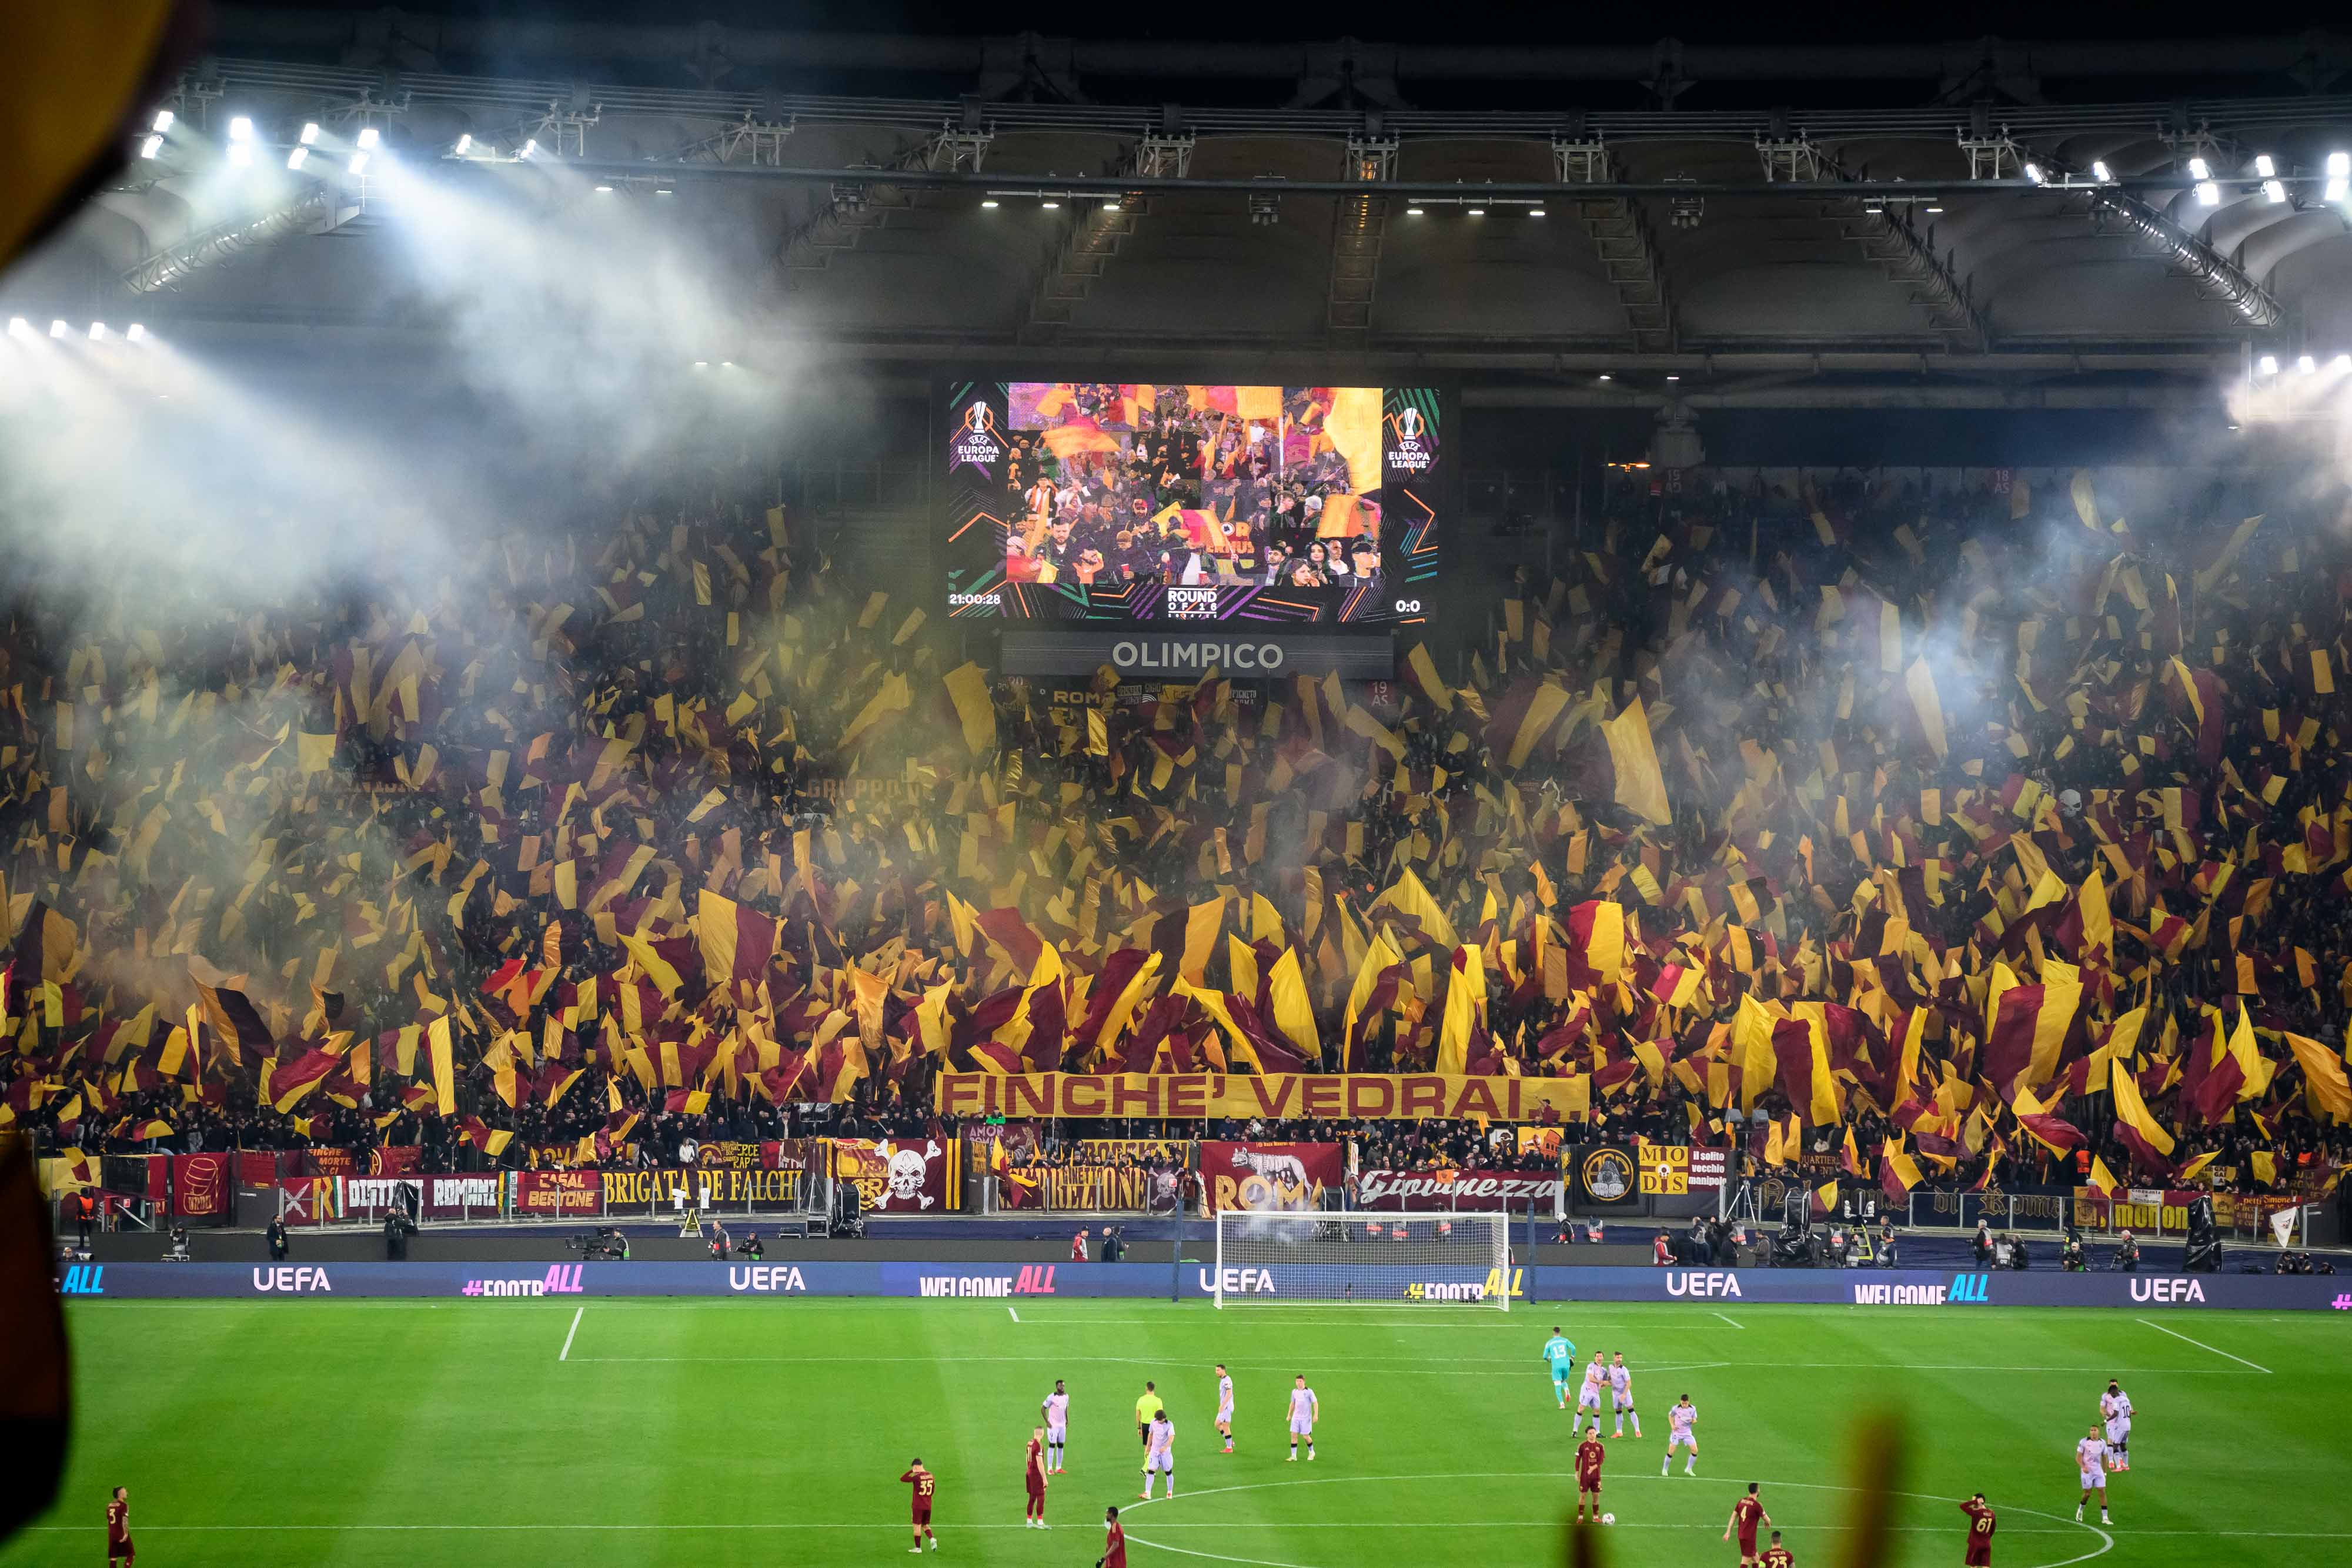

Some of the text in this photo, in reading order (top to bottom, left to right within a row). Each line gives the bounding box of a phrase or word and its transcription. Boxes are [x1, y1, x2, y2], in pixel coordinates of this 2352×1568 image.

[958, 446, 1000, 454] EUROPA
[1388, 452, 1430, 461] EUROPA
[950, 594, 1001, 604] 21:00:28
[1168, 590, 1217, 603] ROUND
[1168, 602, 1217, 611] OF 16
[1395, 600, 1421, 612] 0:0
[1113, 642, 1284, 668] OLIMPICO
[1373, 681, 1388, 694] 19
[1372, 694, 1388, 706] AS
[943, 1075, 1225, 1116] FINCHE'
[970, 1125, 1004, 1137] AMOR
[319, 1157, 351, 1166] MORTE
[1700, 1152, 1725, 1161] solito
[1692, 1164, 1725, 1173] vecchio
[540, 1174, 584, 1188] CASAL
[602, 1169, 803, 1203] BRIGATA DE FALCHI
[1361, 1171, 1557, 1204] Giovinezza
[1688, 1176, 1726, 1186] manipolo
[433, 1179, 497, 1206] ROMANI
[529, 1191, 595, 1207] BERTONE
[1215, 1175, 1323, 1211] ROMA
[62, 1266, 103, 1293] ALL
[253, 1267, 331, 1291] UEFA
[730, 1266, 806, 1290] UEFA
[920, 1265, 1055, 1297] WELCOME ALL
[1200, 1268, 1275, 1292] UEFA
[1666, 1272, 1742, 1296] UEFA
[1855, 1274, 1988, 1305] WELCOME ALL
[2131, 1278, 2205, 1302] UEFA
[1553, 1345, 1566, 1359] 13
[2122, 1405, 2131, 1419] 10
[918, 1479, 934, 1496] 35
[109, 1508, 116, 1524] 3
[1740, 1506, 1747, 1522] 4
[1976, 1517, 1993, 1534] 61
[1769, 1556, 1788, 1568] 23
